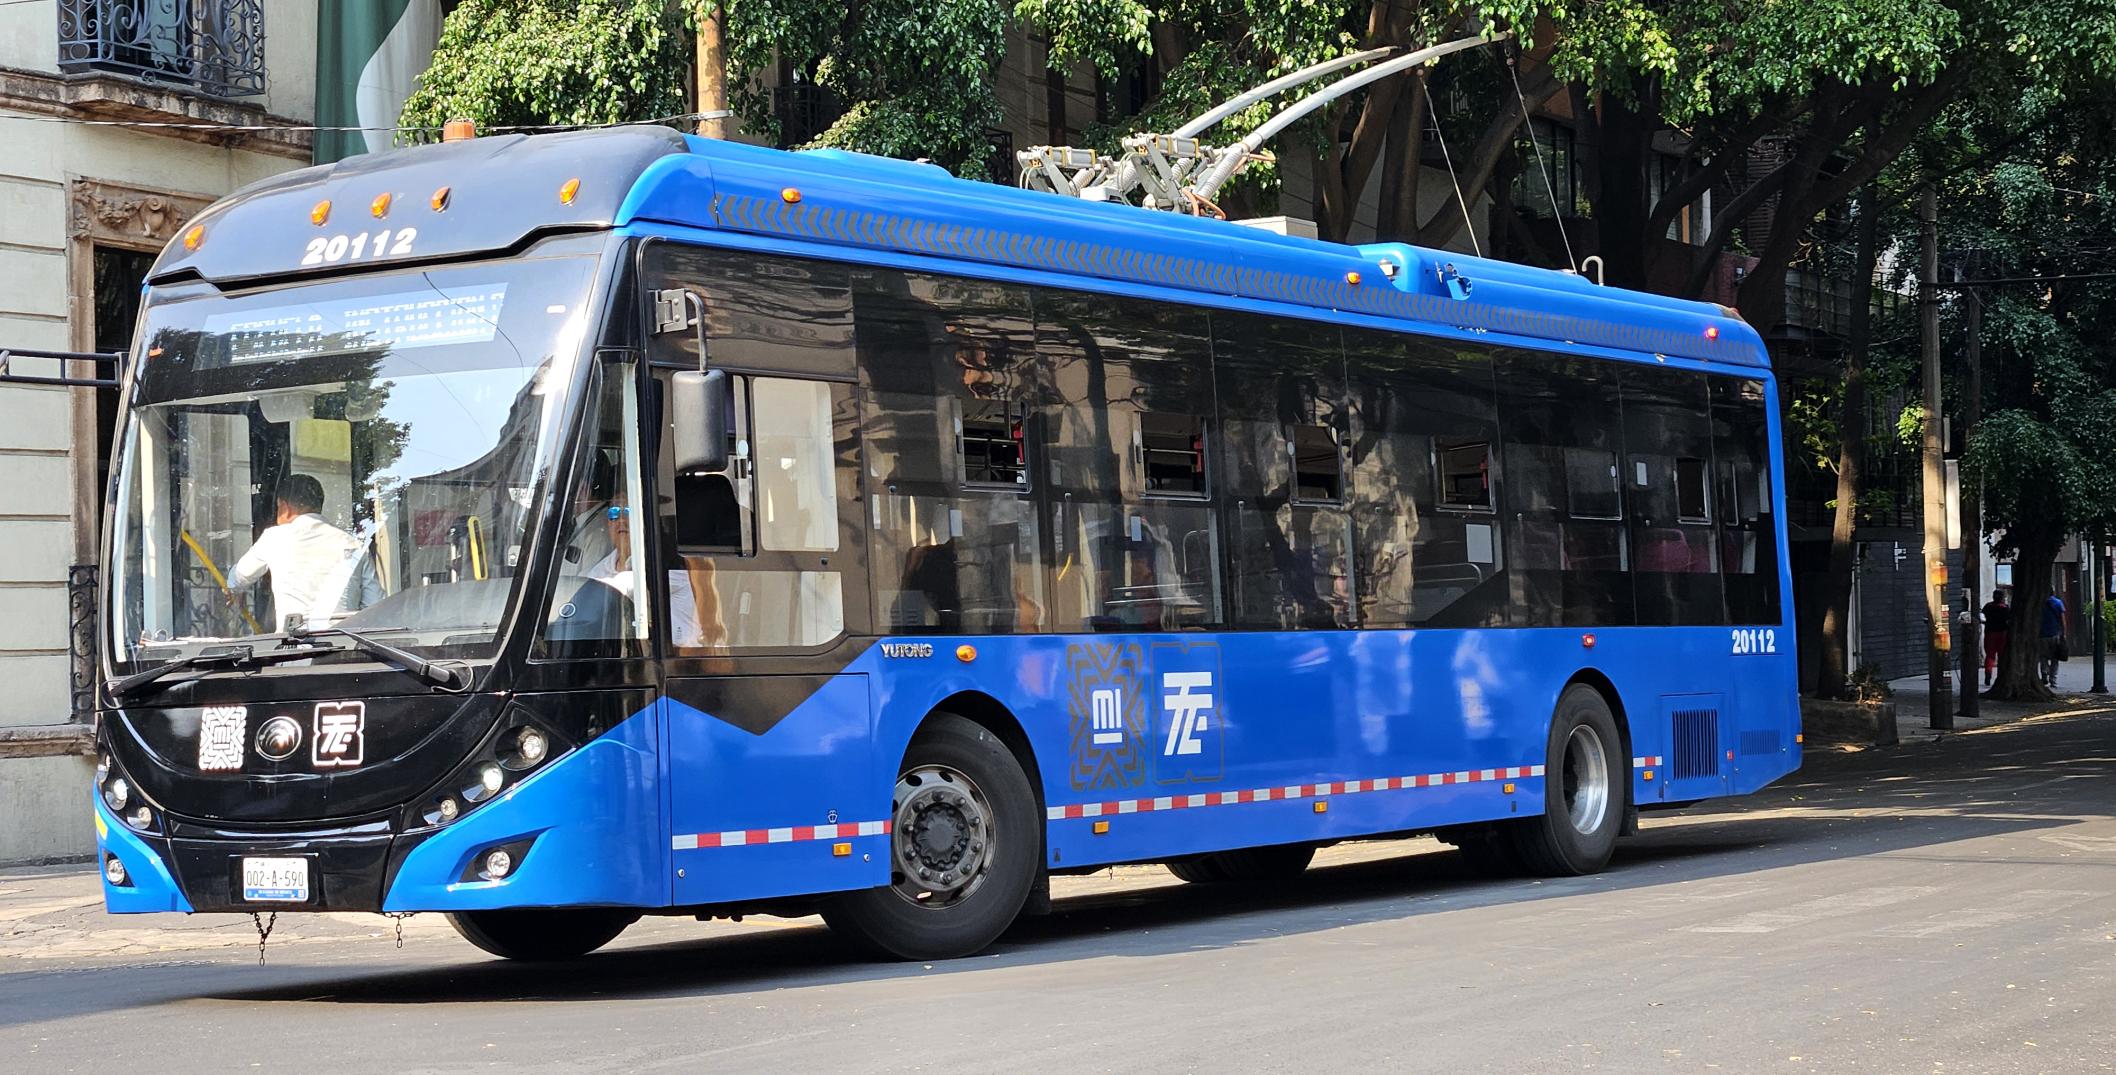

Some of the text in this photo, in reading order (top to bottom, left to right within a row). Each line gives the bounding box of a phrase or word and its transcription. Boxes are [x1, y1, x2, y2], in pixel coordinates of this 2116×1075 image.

[301, 227, 417, 265] 20112
[880, 643, 934, 658] YUTONG
[1732, 629, 1775, 654] 20112
[246, 870, 304, 887] 002-A-590
